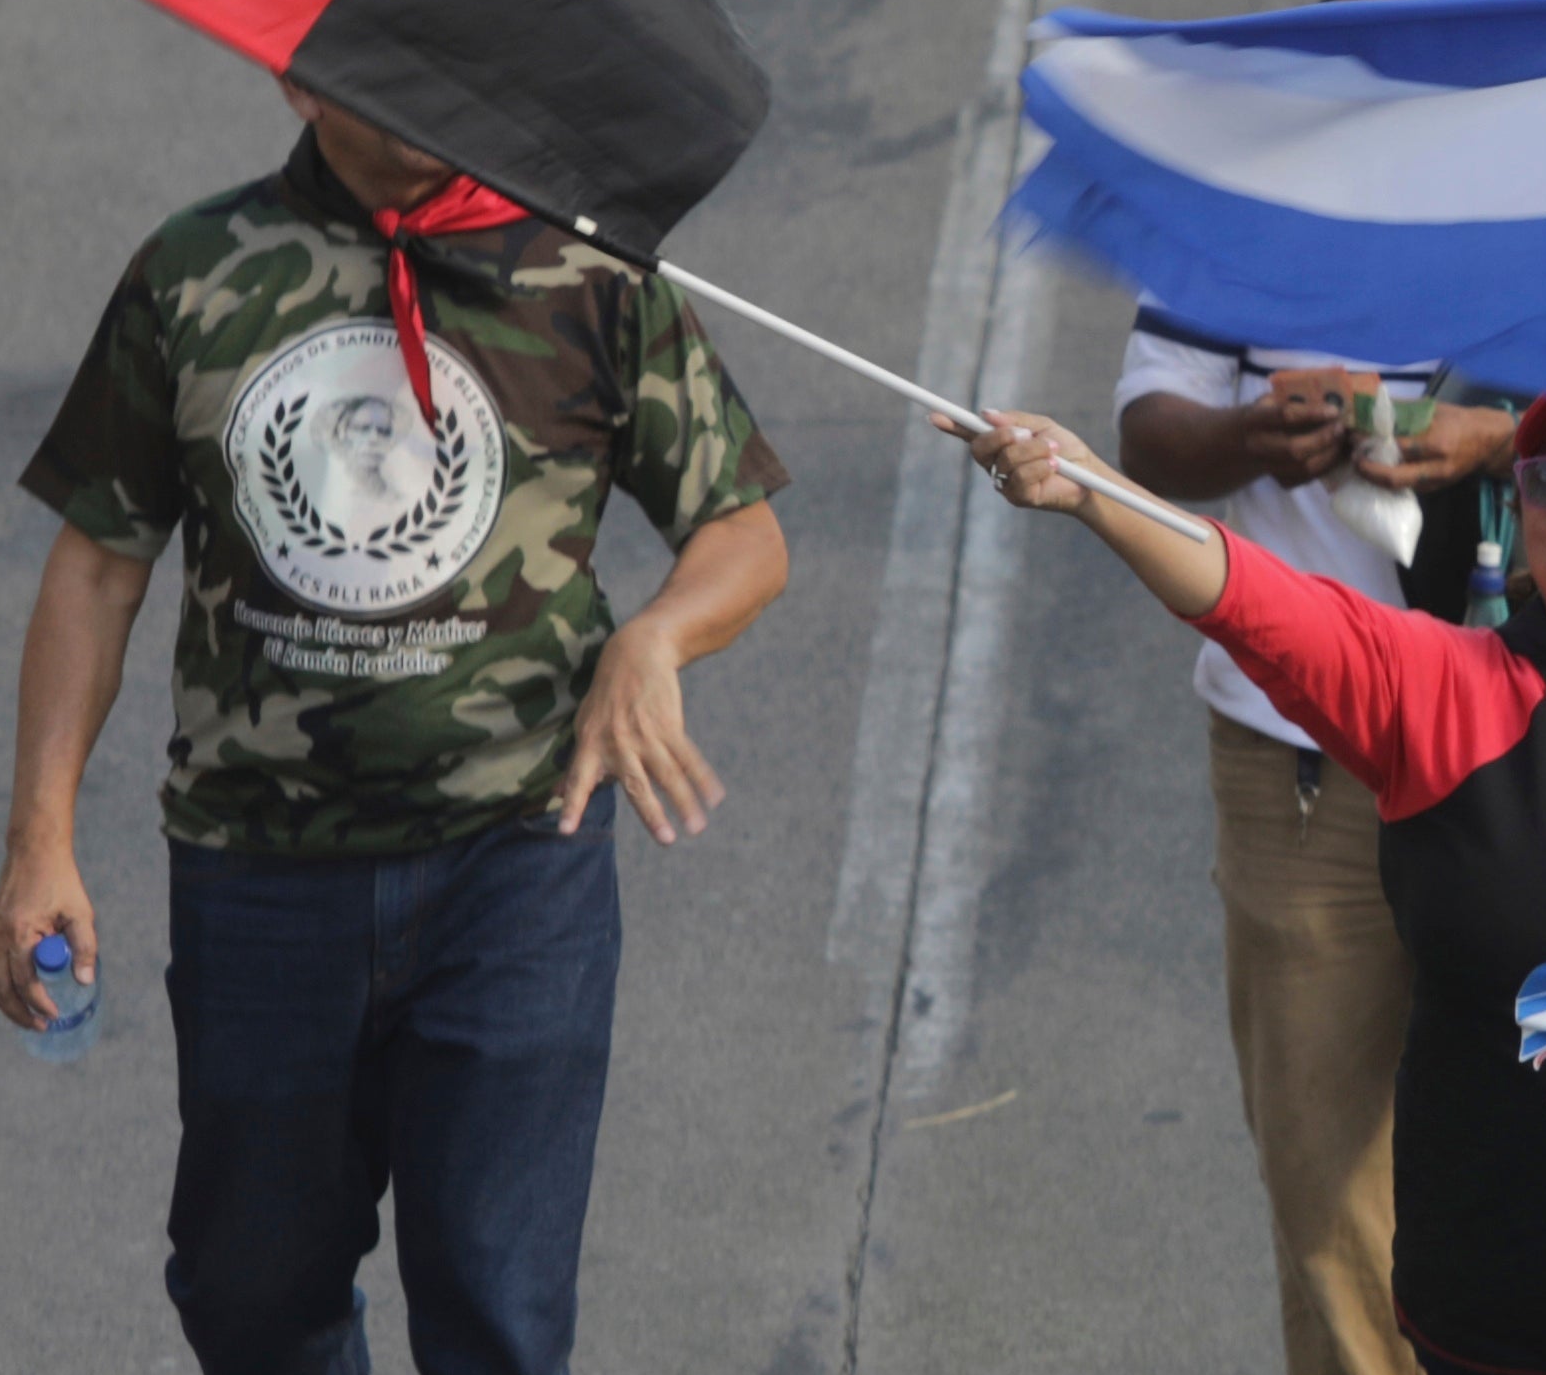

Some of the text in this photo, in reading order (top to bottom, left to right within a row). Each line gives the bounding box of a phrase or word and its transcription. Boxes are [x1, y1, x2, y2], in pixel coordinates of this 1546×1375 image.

[307, 339, 329, 357] DE
[336, 331, 400, 349] SANDI
[328, 583, 362, 603] BLI
[368, 574, 425, 603] RARA
